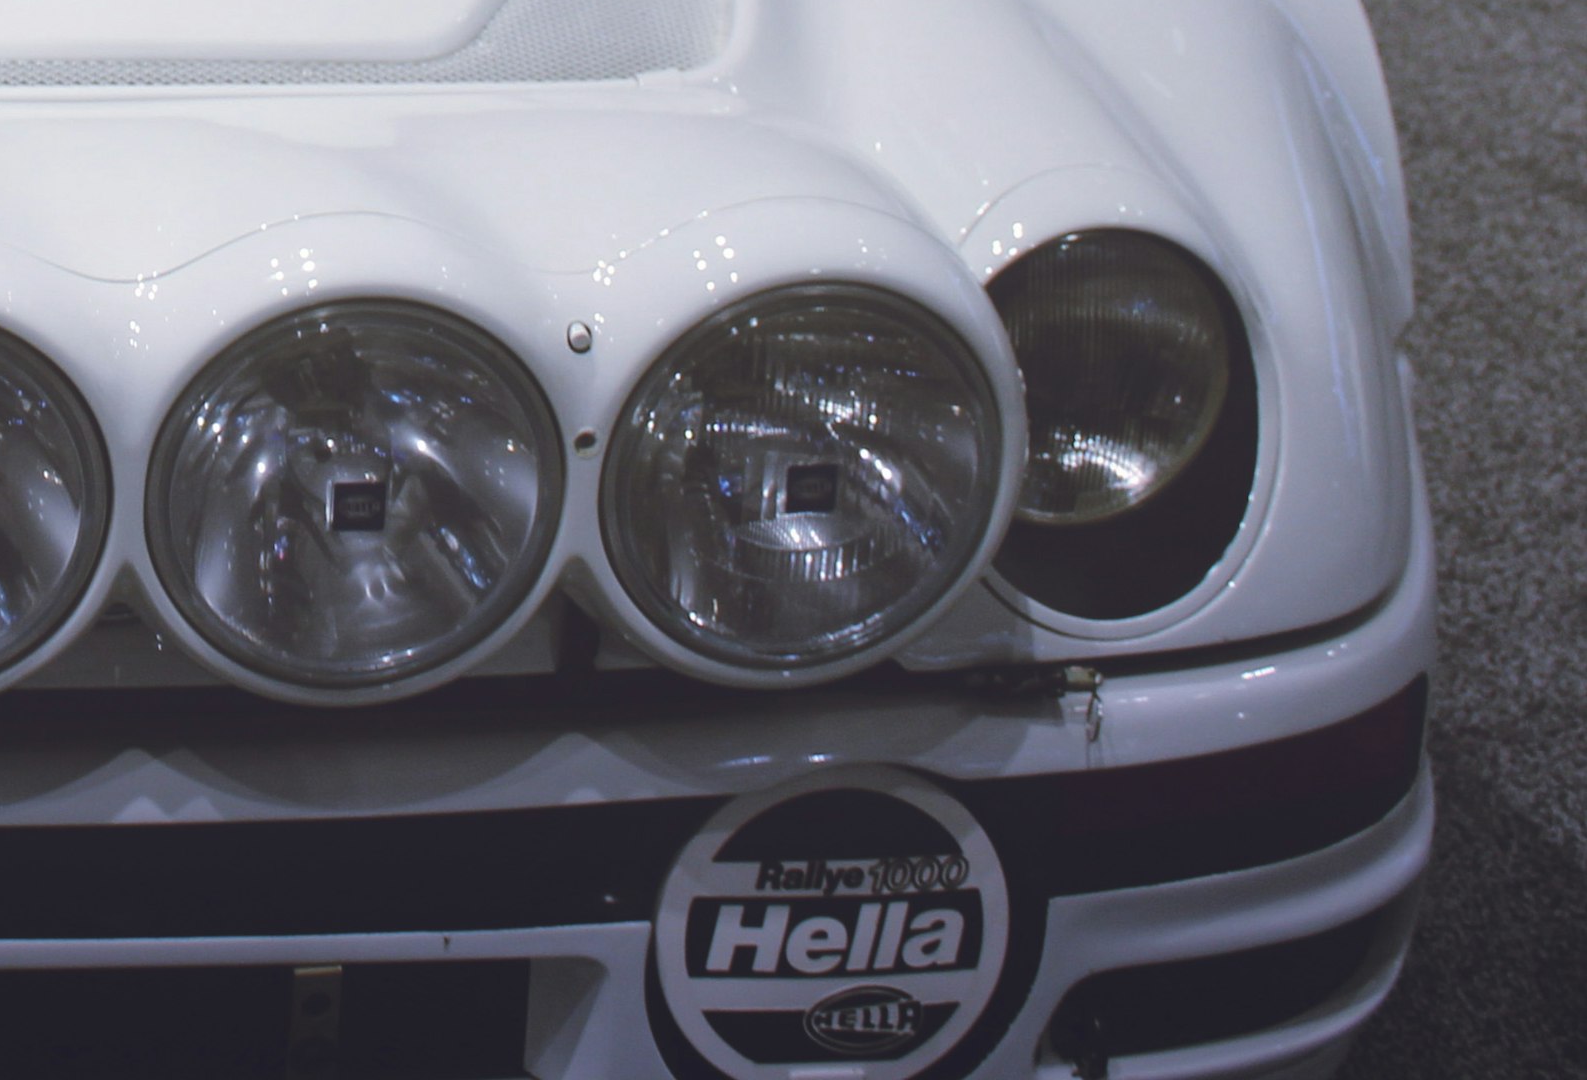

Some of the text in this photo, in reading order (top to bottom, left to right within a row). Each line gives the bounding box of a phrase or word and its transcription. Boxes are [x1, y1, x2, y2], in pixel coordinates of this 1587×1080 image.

[755, 853, 969, 895] Rallye 1000
[705, 901, 965, 974] Hella
[812, 1000, 921, 1035] HELLA
